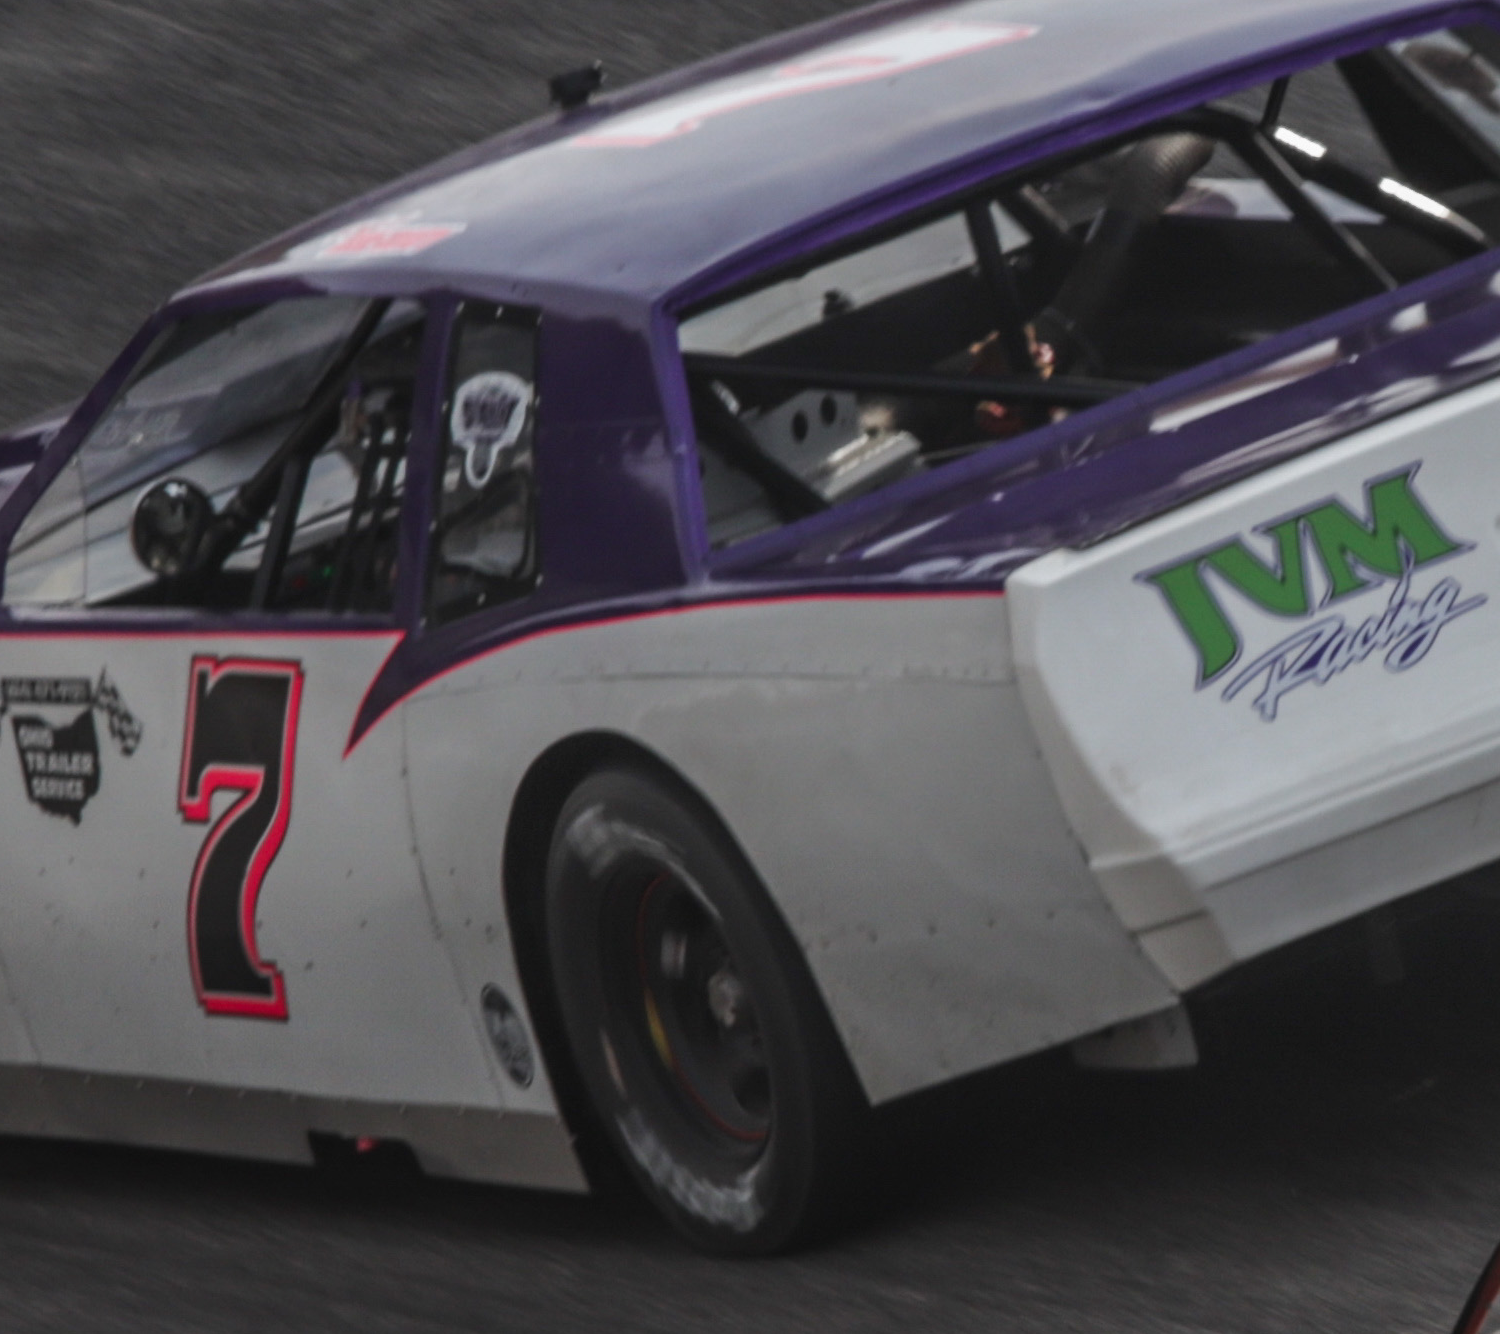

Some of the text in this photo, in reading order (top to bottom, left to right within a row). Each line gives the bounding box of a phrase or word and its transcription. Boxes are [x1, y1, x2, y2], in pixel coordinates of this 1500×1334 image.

[1221, 578, 1488, 722] Racing
[24, 751, 94, 776] TRAILER
[31, 776, 85, 801] SERVICE
[178, 654, 305, 1021] 7
